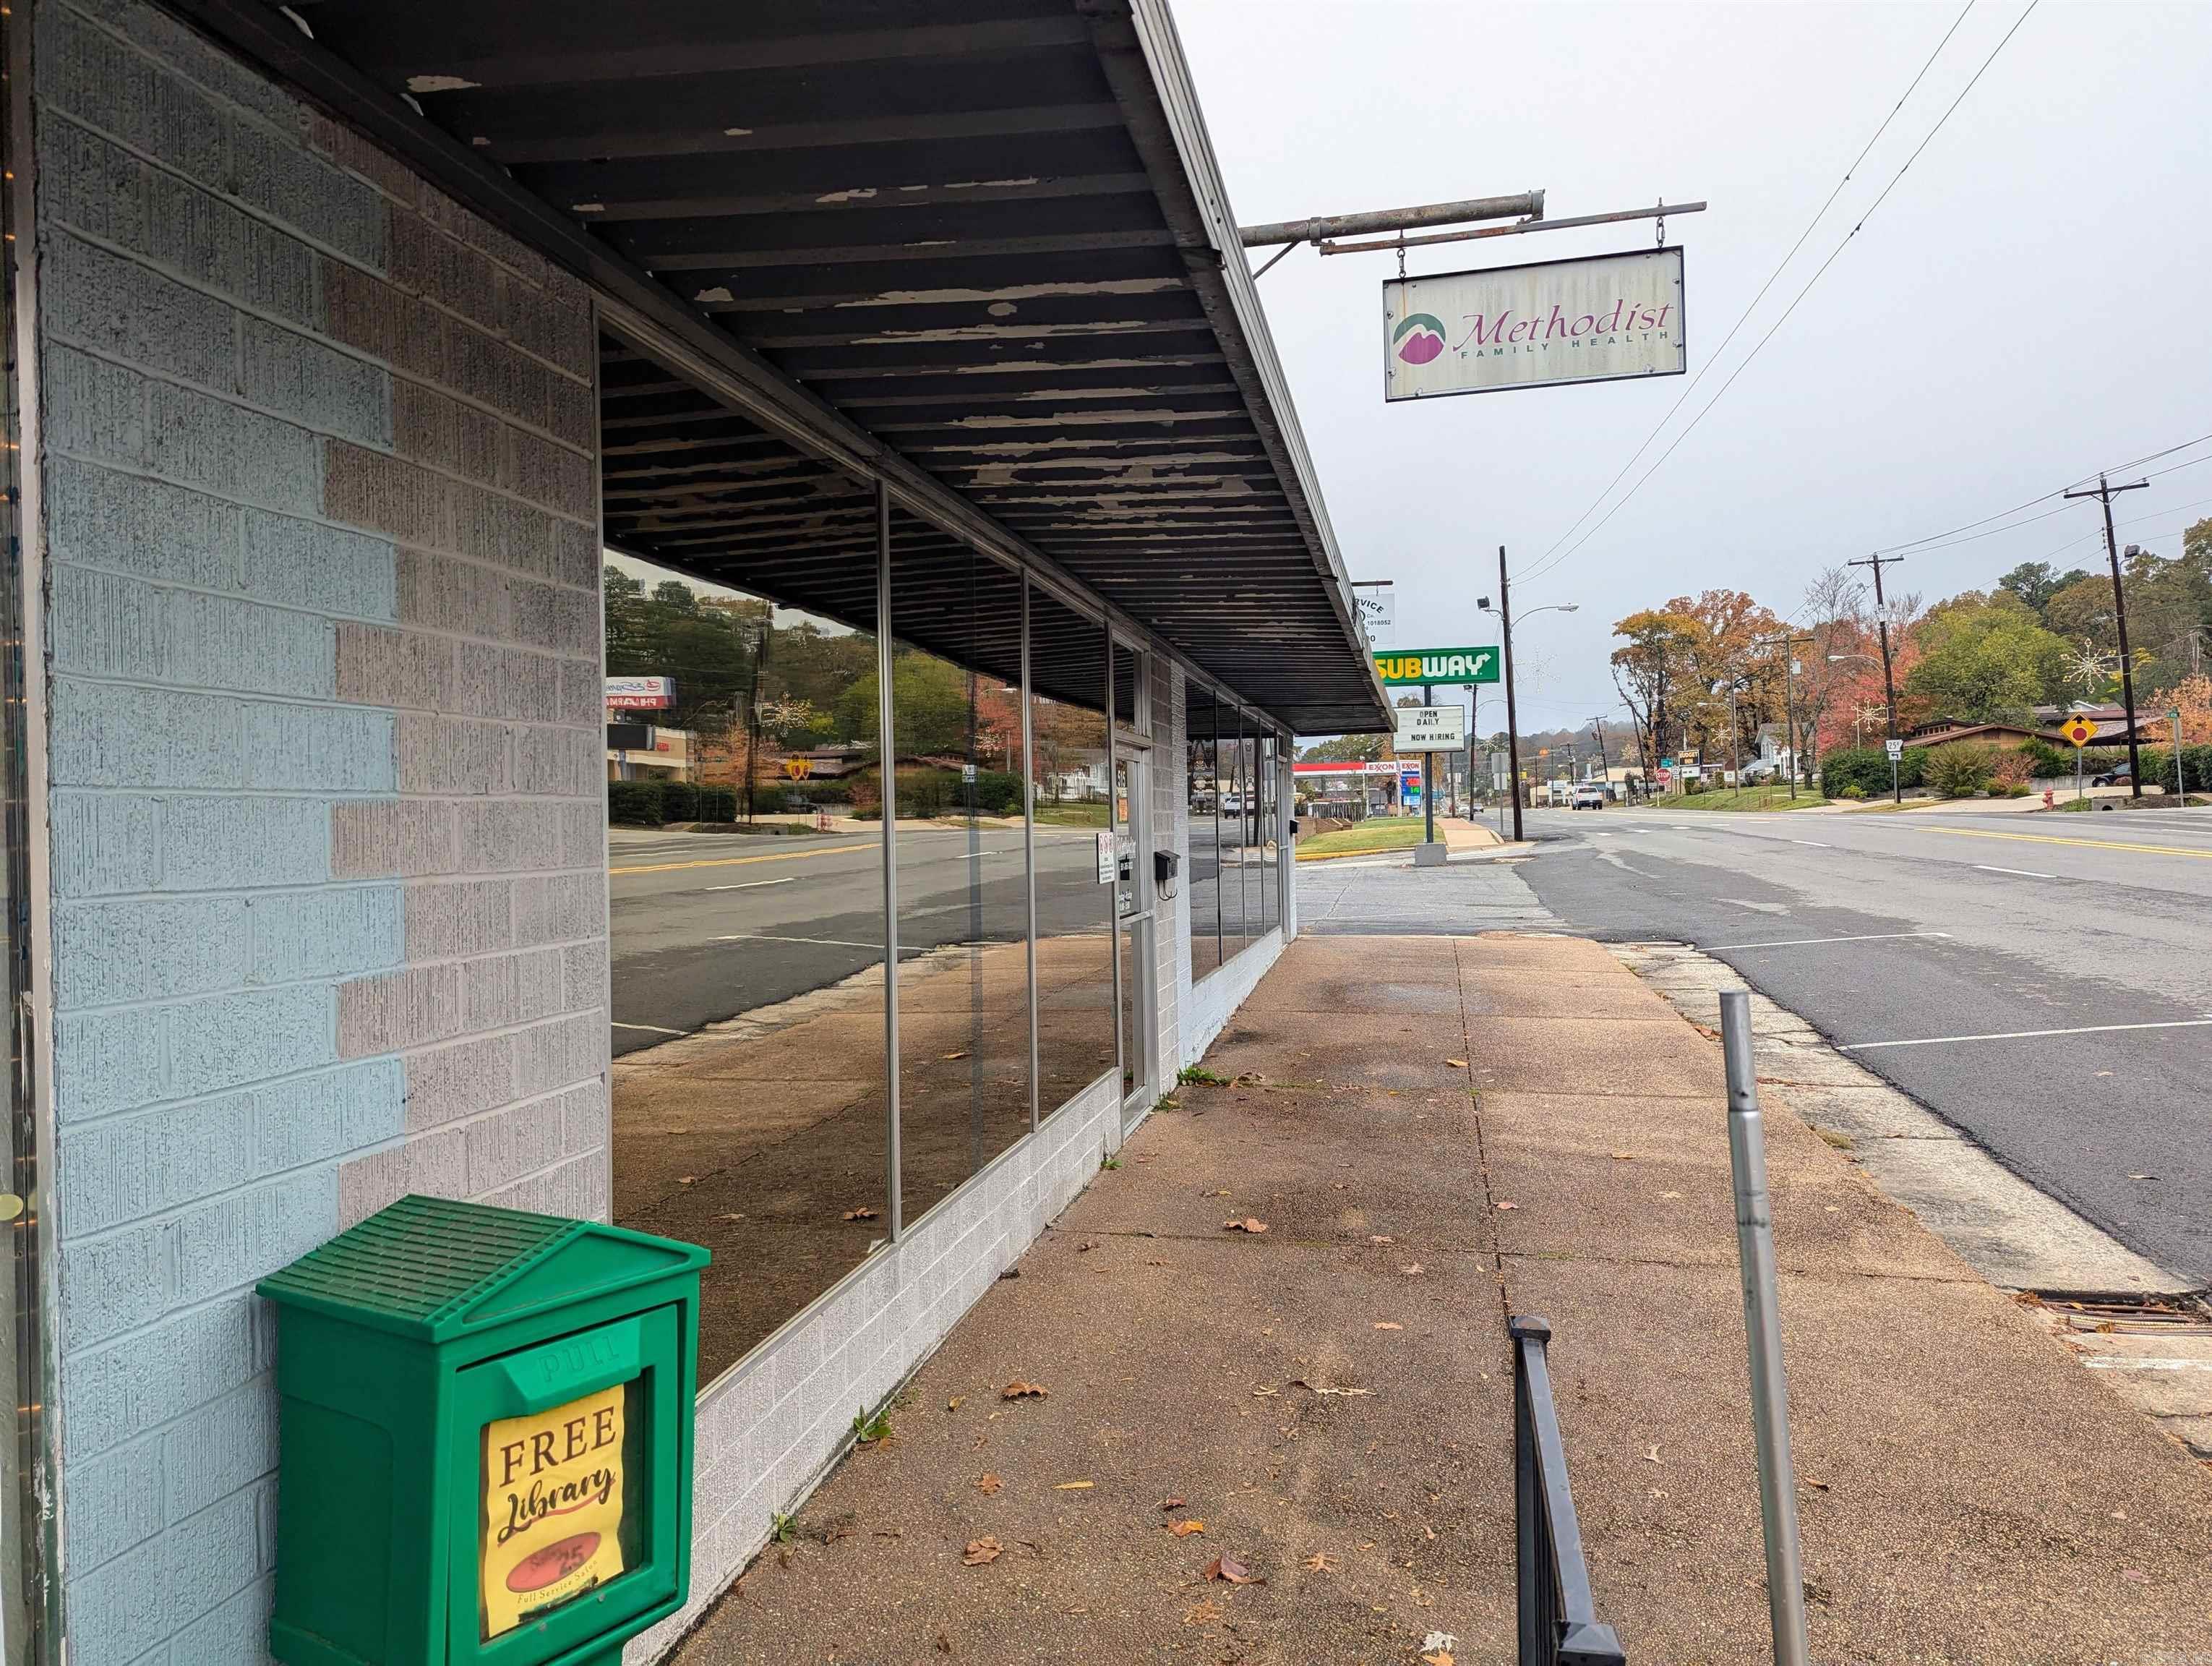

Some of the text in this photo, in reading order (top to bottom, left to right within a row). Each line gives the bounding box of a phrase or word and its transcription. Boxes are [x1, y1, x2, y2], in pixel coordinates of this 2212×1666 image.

[1452, 299, 1674, 351] Methodist
[1461, 331, 1668, 359] FAMILY HEALTH
[1368, 763, 1394, 772] EXXON
[1402, 762, 1420, 771] EXXON
[537, 1336, 620, 1383] PULL
[499, 1406, 617, 1488] FREE
[497, 1466, 615, 1544] Library
